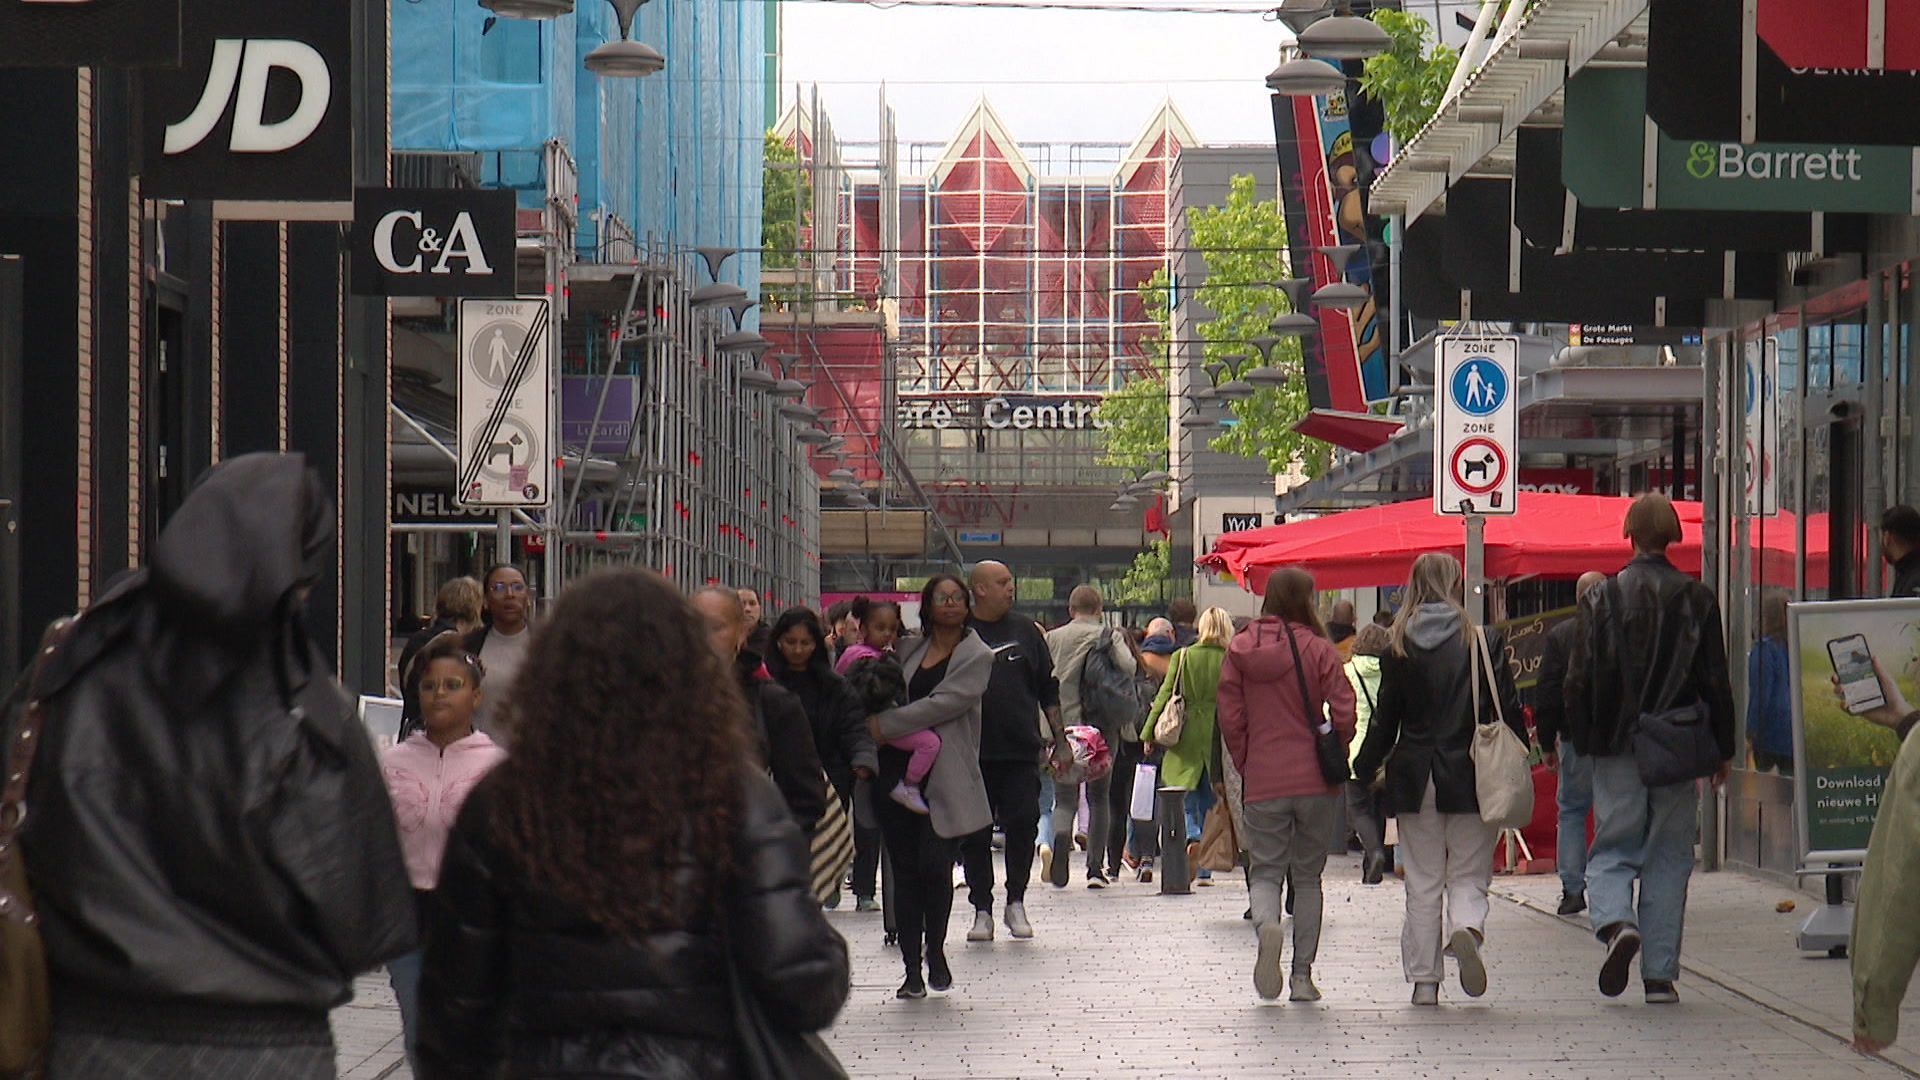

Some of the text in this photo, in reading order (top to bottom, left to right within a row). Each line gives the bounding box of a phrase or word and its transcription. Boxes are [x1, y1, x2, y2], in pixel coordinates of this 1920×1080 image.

[163, 39, 331, 154] JD
[373, 210, 493, 274] C&A
[486, 304, 523, 315] ZONE
[1464, 344, 1495, 353] ZONE
[486, 399, 522, 410] ZE
[1463, 423, 1495, 433] ZONE
[1817, 775, 1881, 789] Download
[1817, 796, 1862, 808] nieuwe
